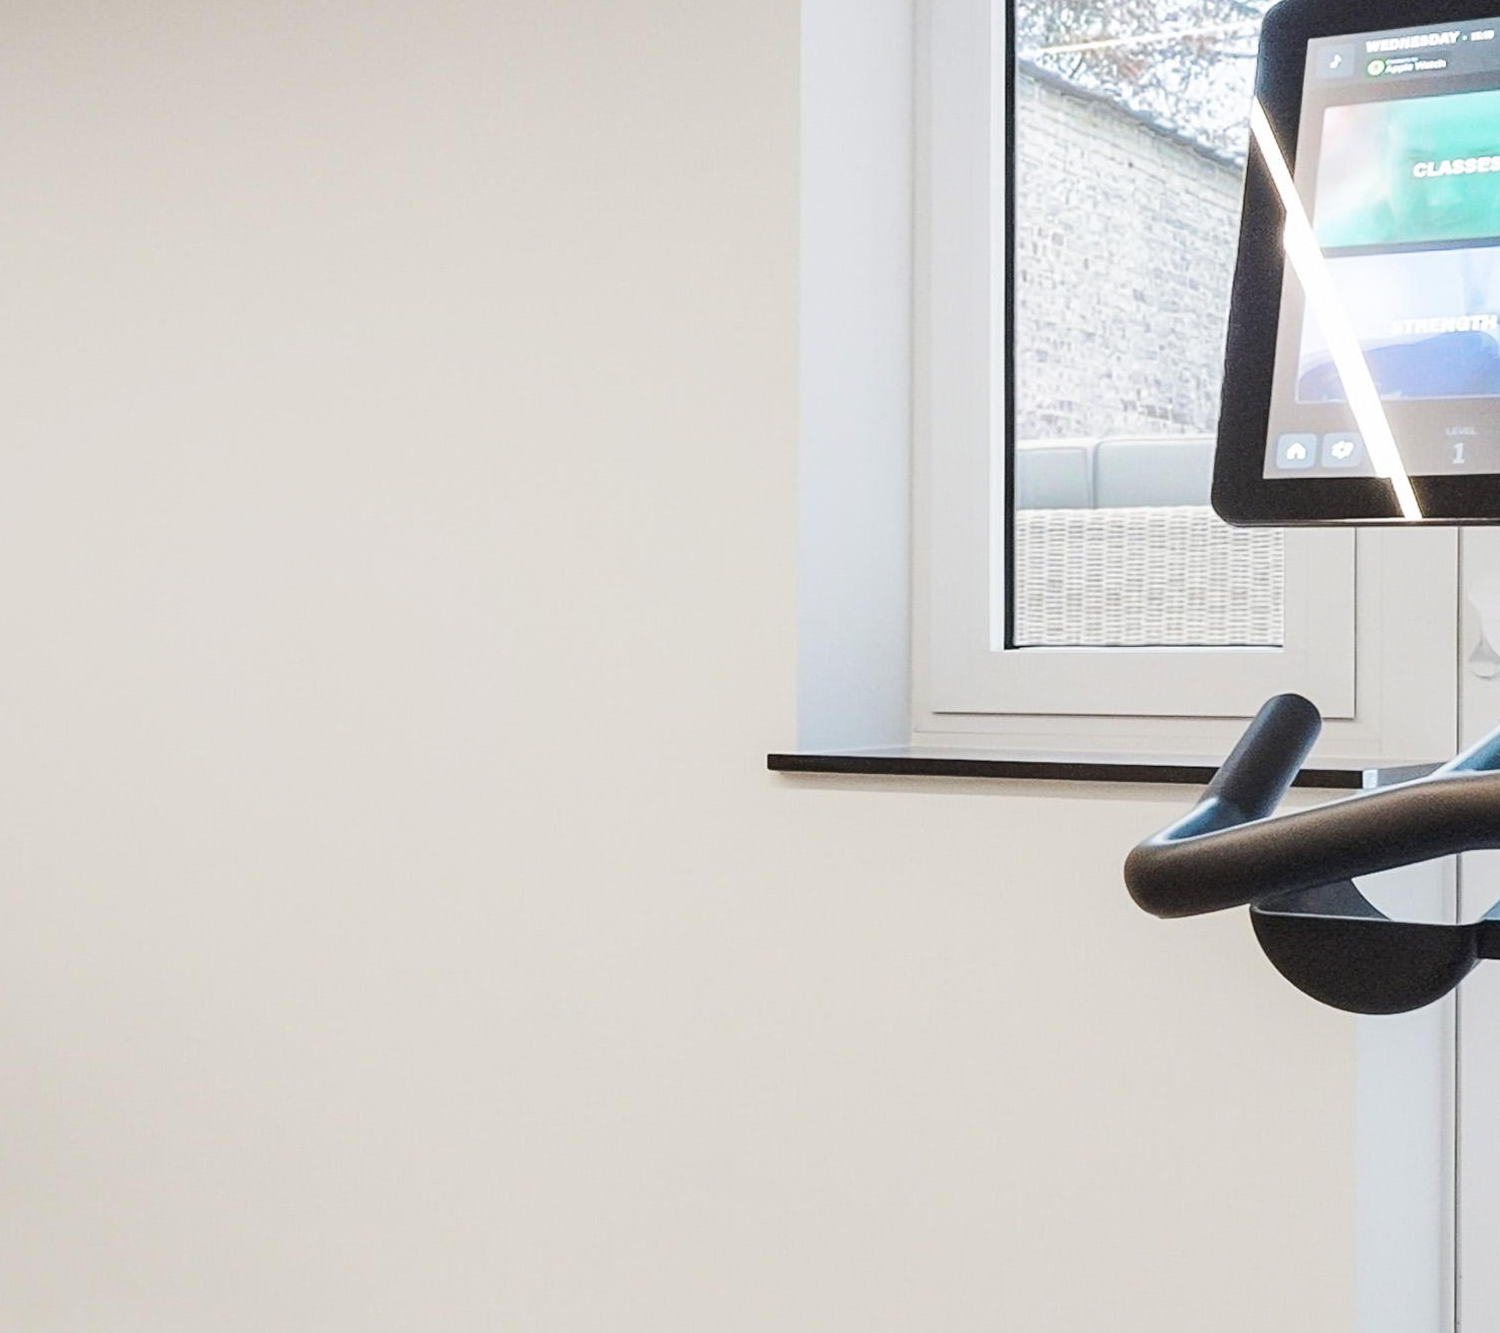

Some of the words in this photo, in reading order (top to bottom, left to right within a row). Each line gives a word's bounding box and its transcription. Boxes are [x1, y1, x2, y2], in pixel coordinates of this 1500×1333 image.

[1365, 30, 1461, 53] WEDNESDAY
[1389, 314, 1499, 336] STRENGTH
[1453, 443, 1465, 464] 1
